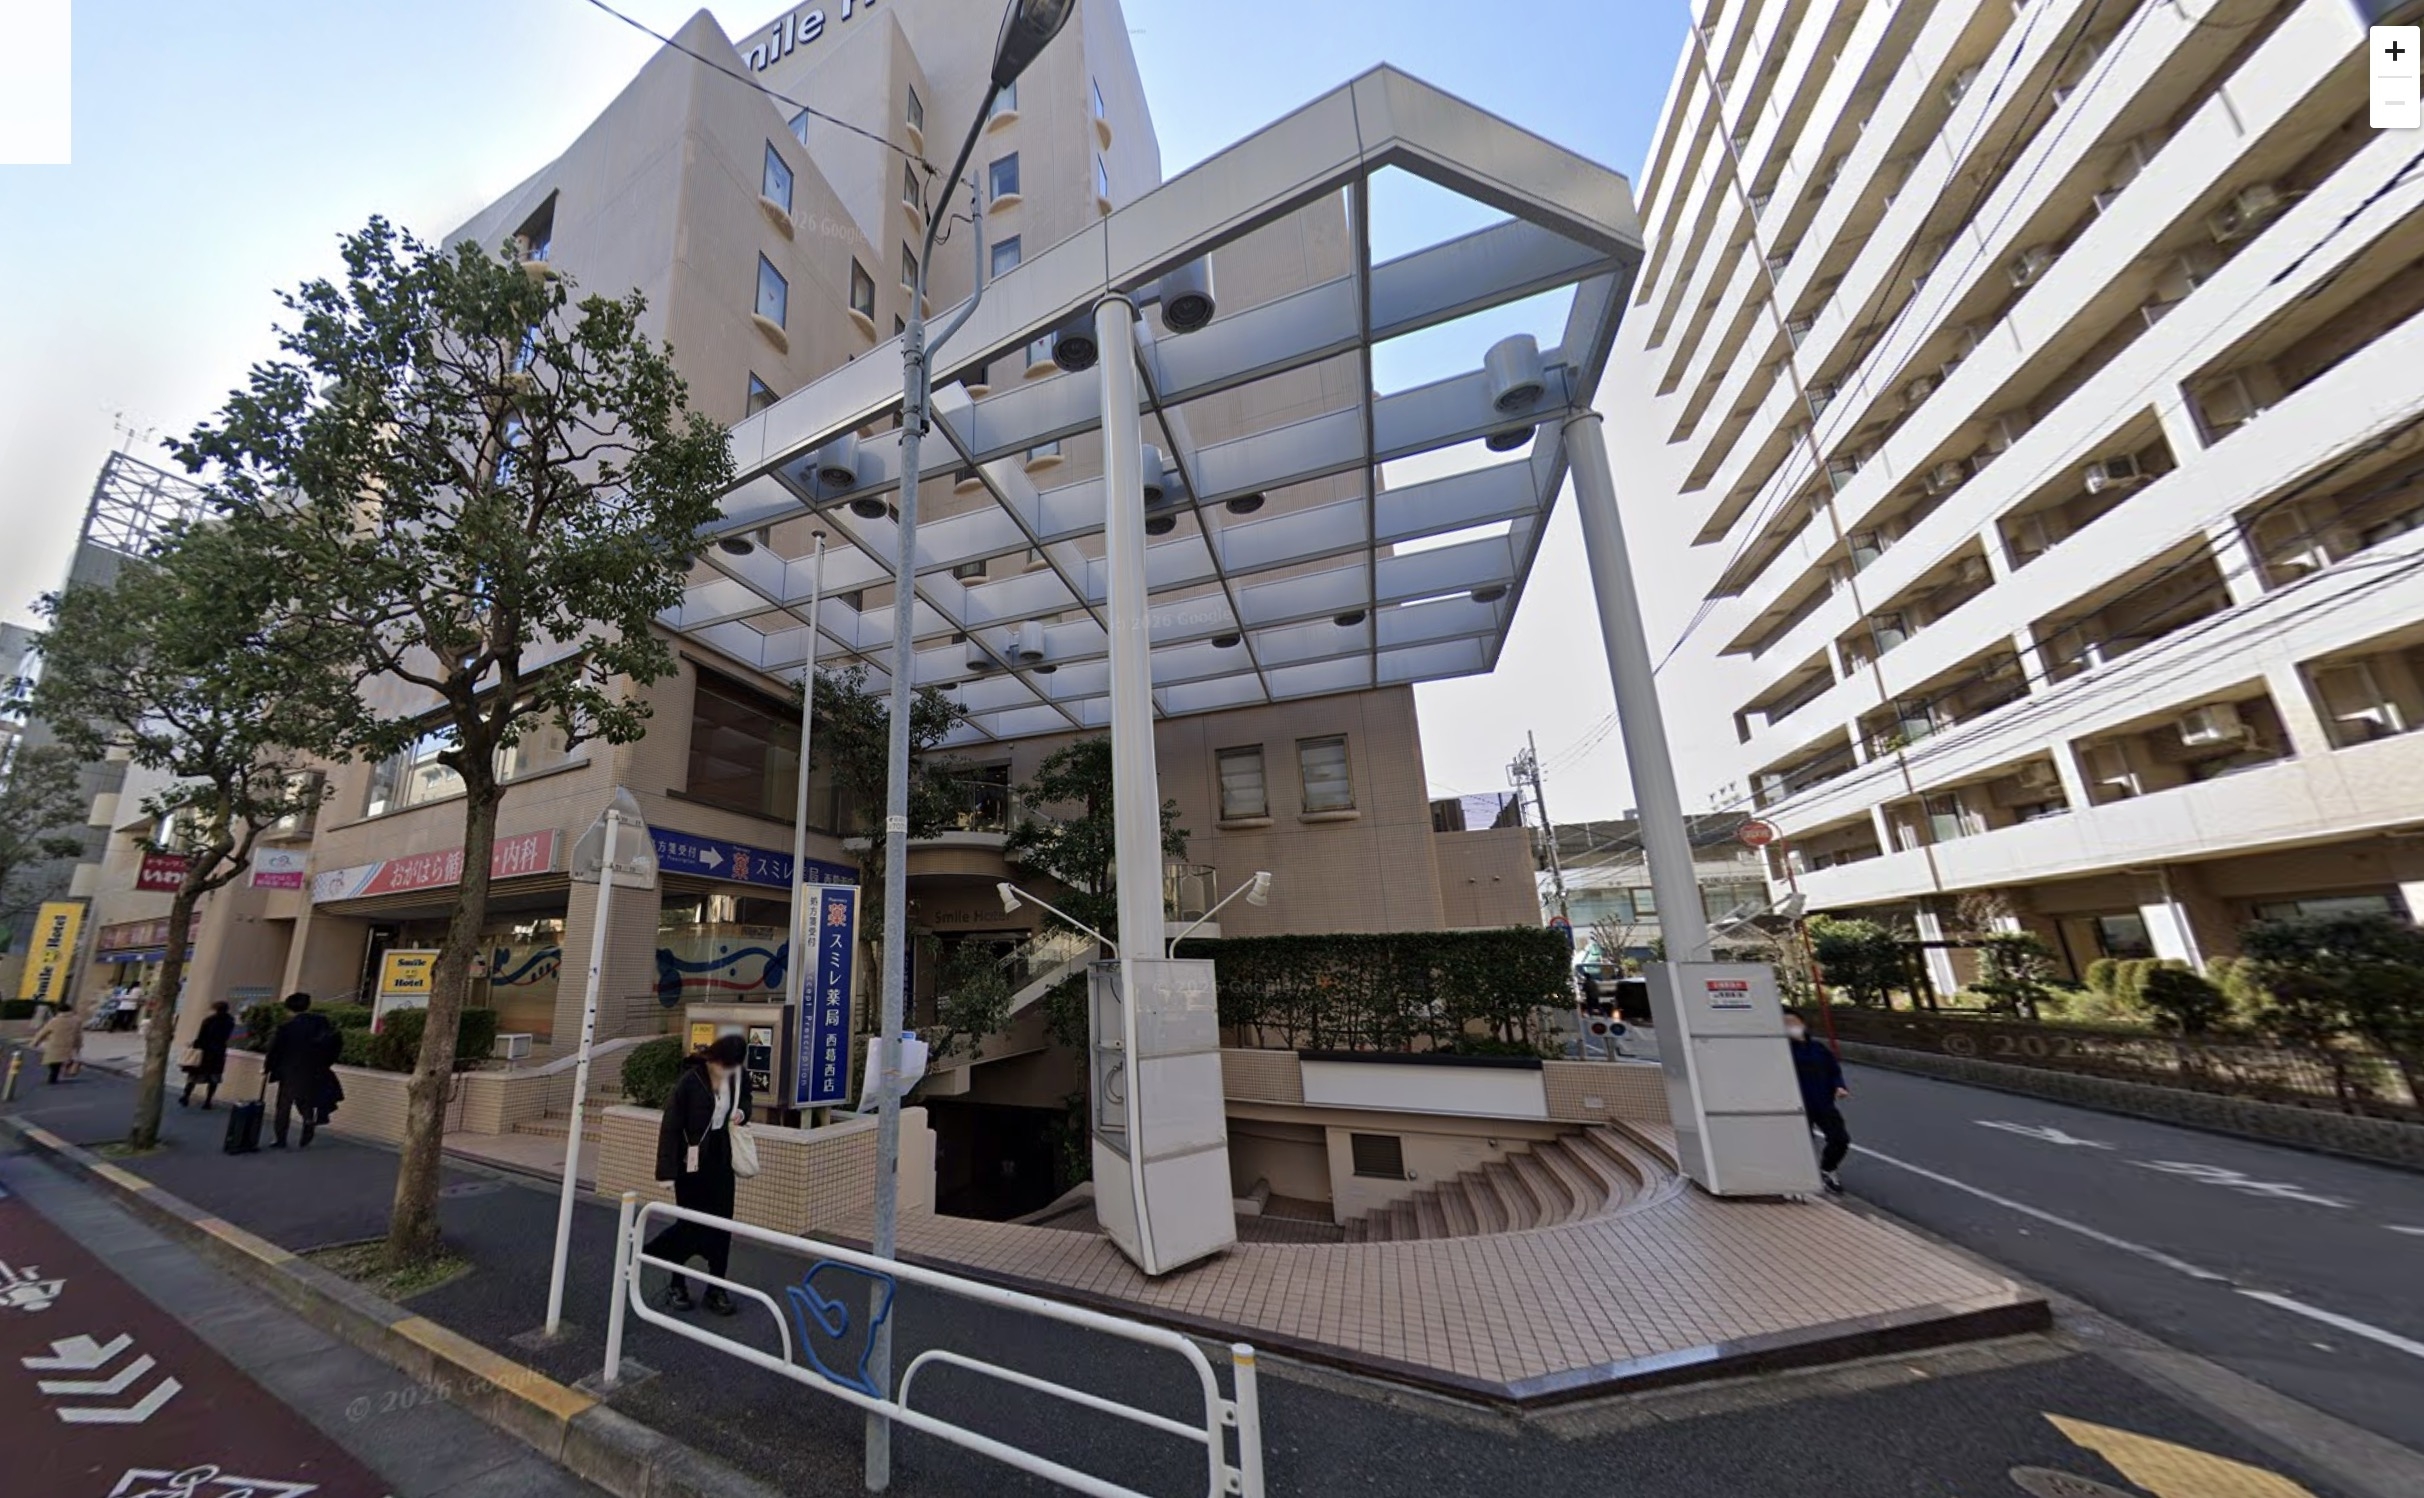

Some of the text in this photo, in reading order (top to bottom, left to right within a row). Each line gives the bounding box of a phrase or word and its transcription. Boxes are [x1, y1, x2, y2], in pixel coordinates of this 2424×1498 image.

[742, 9, 826, 72] mile
[390, 837, 537, 888] おがはら循・内科
[657, 840, 697, 859] 方箋受付
[756, 858, 819, 884] スミレ局
[934, 908, 970, 924] Smile
[46, 915, 68, 948] Hotel
[397, 958, 427, 967] Smile
[395, 979, 424, 987] Hotel
[823, 933, 843, 1093] スミレ薬局 西葛西店
